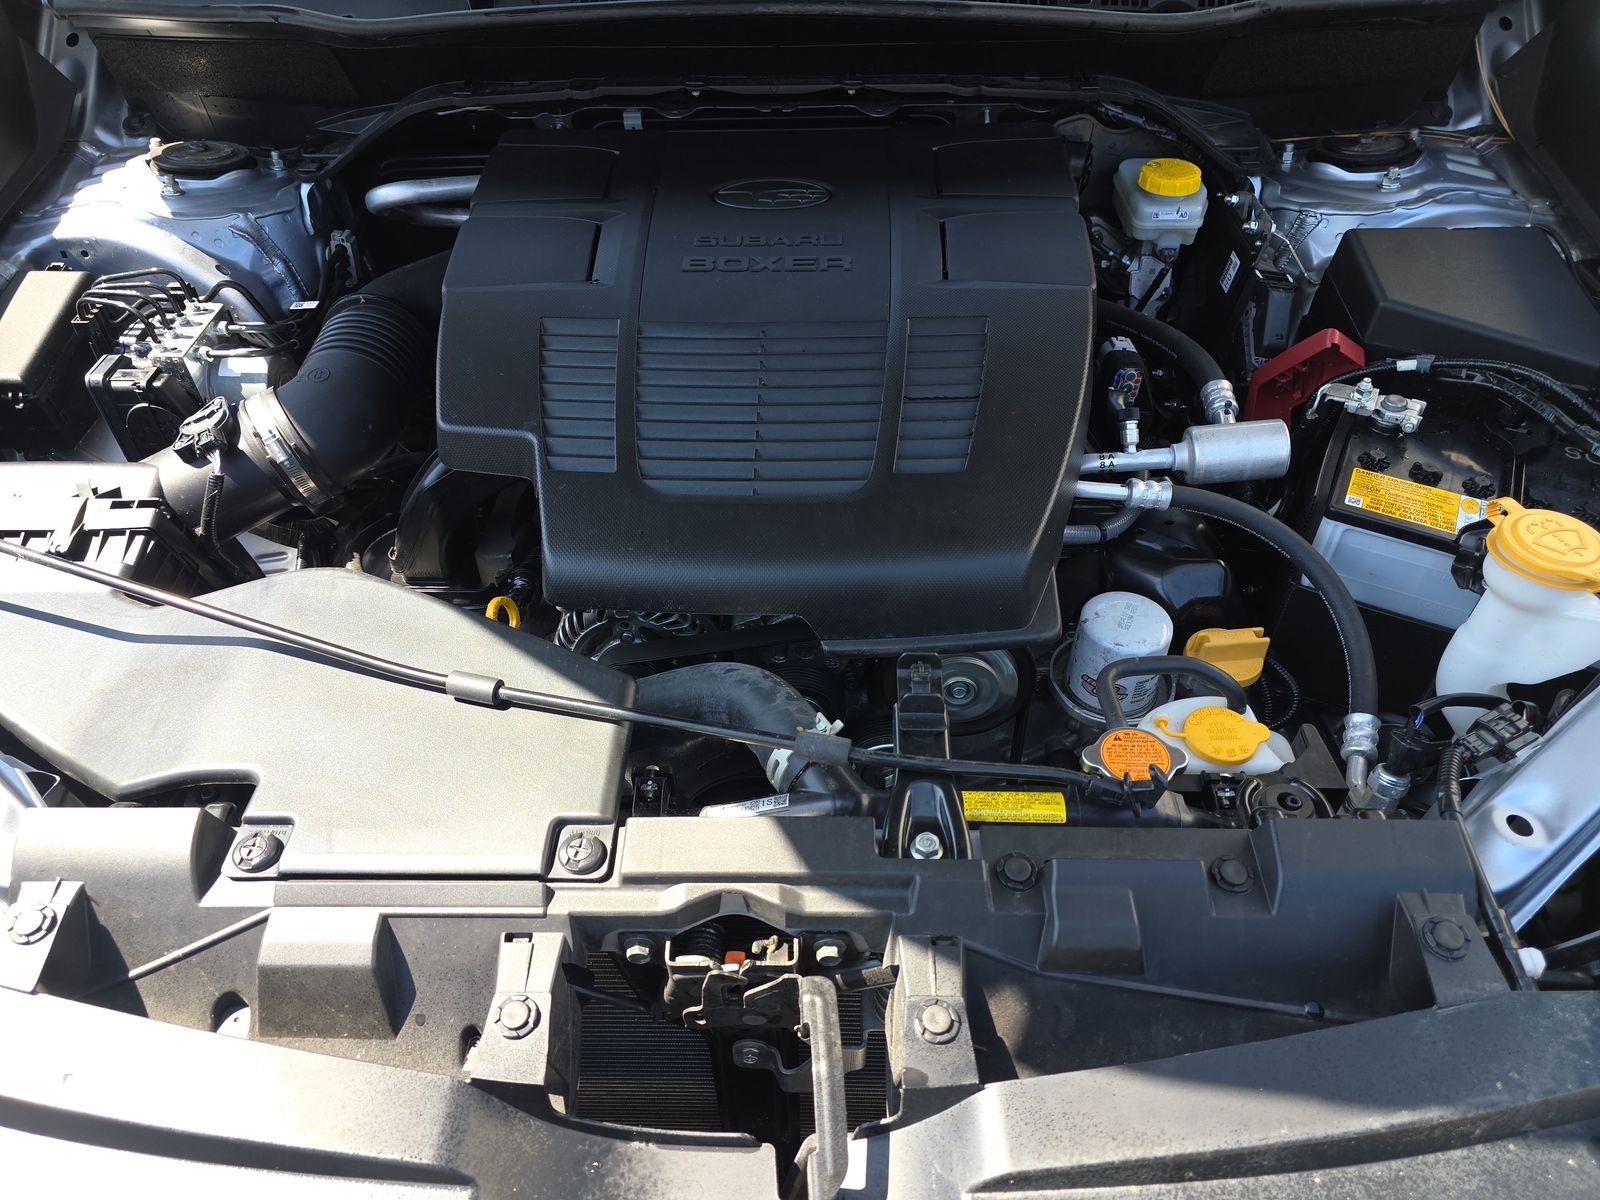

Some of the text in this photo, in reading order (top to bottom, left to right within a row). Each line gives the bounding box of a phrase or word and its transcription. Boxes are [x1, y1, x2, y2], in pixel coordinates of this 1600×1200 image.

[694, 234, 846, 247] SUBARU
[682, 255, 852, 272] BOXER
[1356, 469, 1386, 481] DANGER
[1352, 482, 1381, 494] POISON
[1399, 513, 1412, 521] CCA
